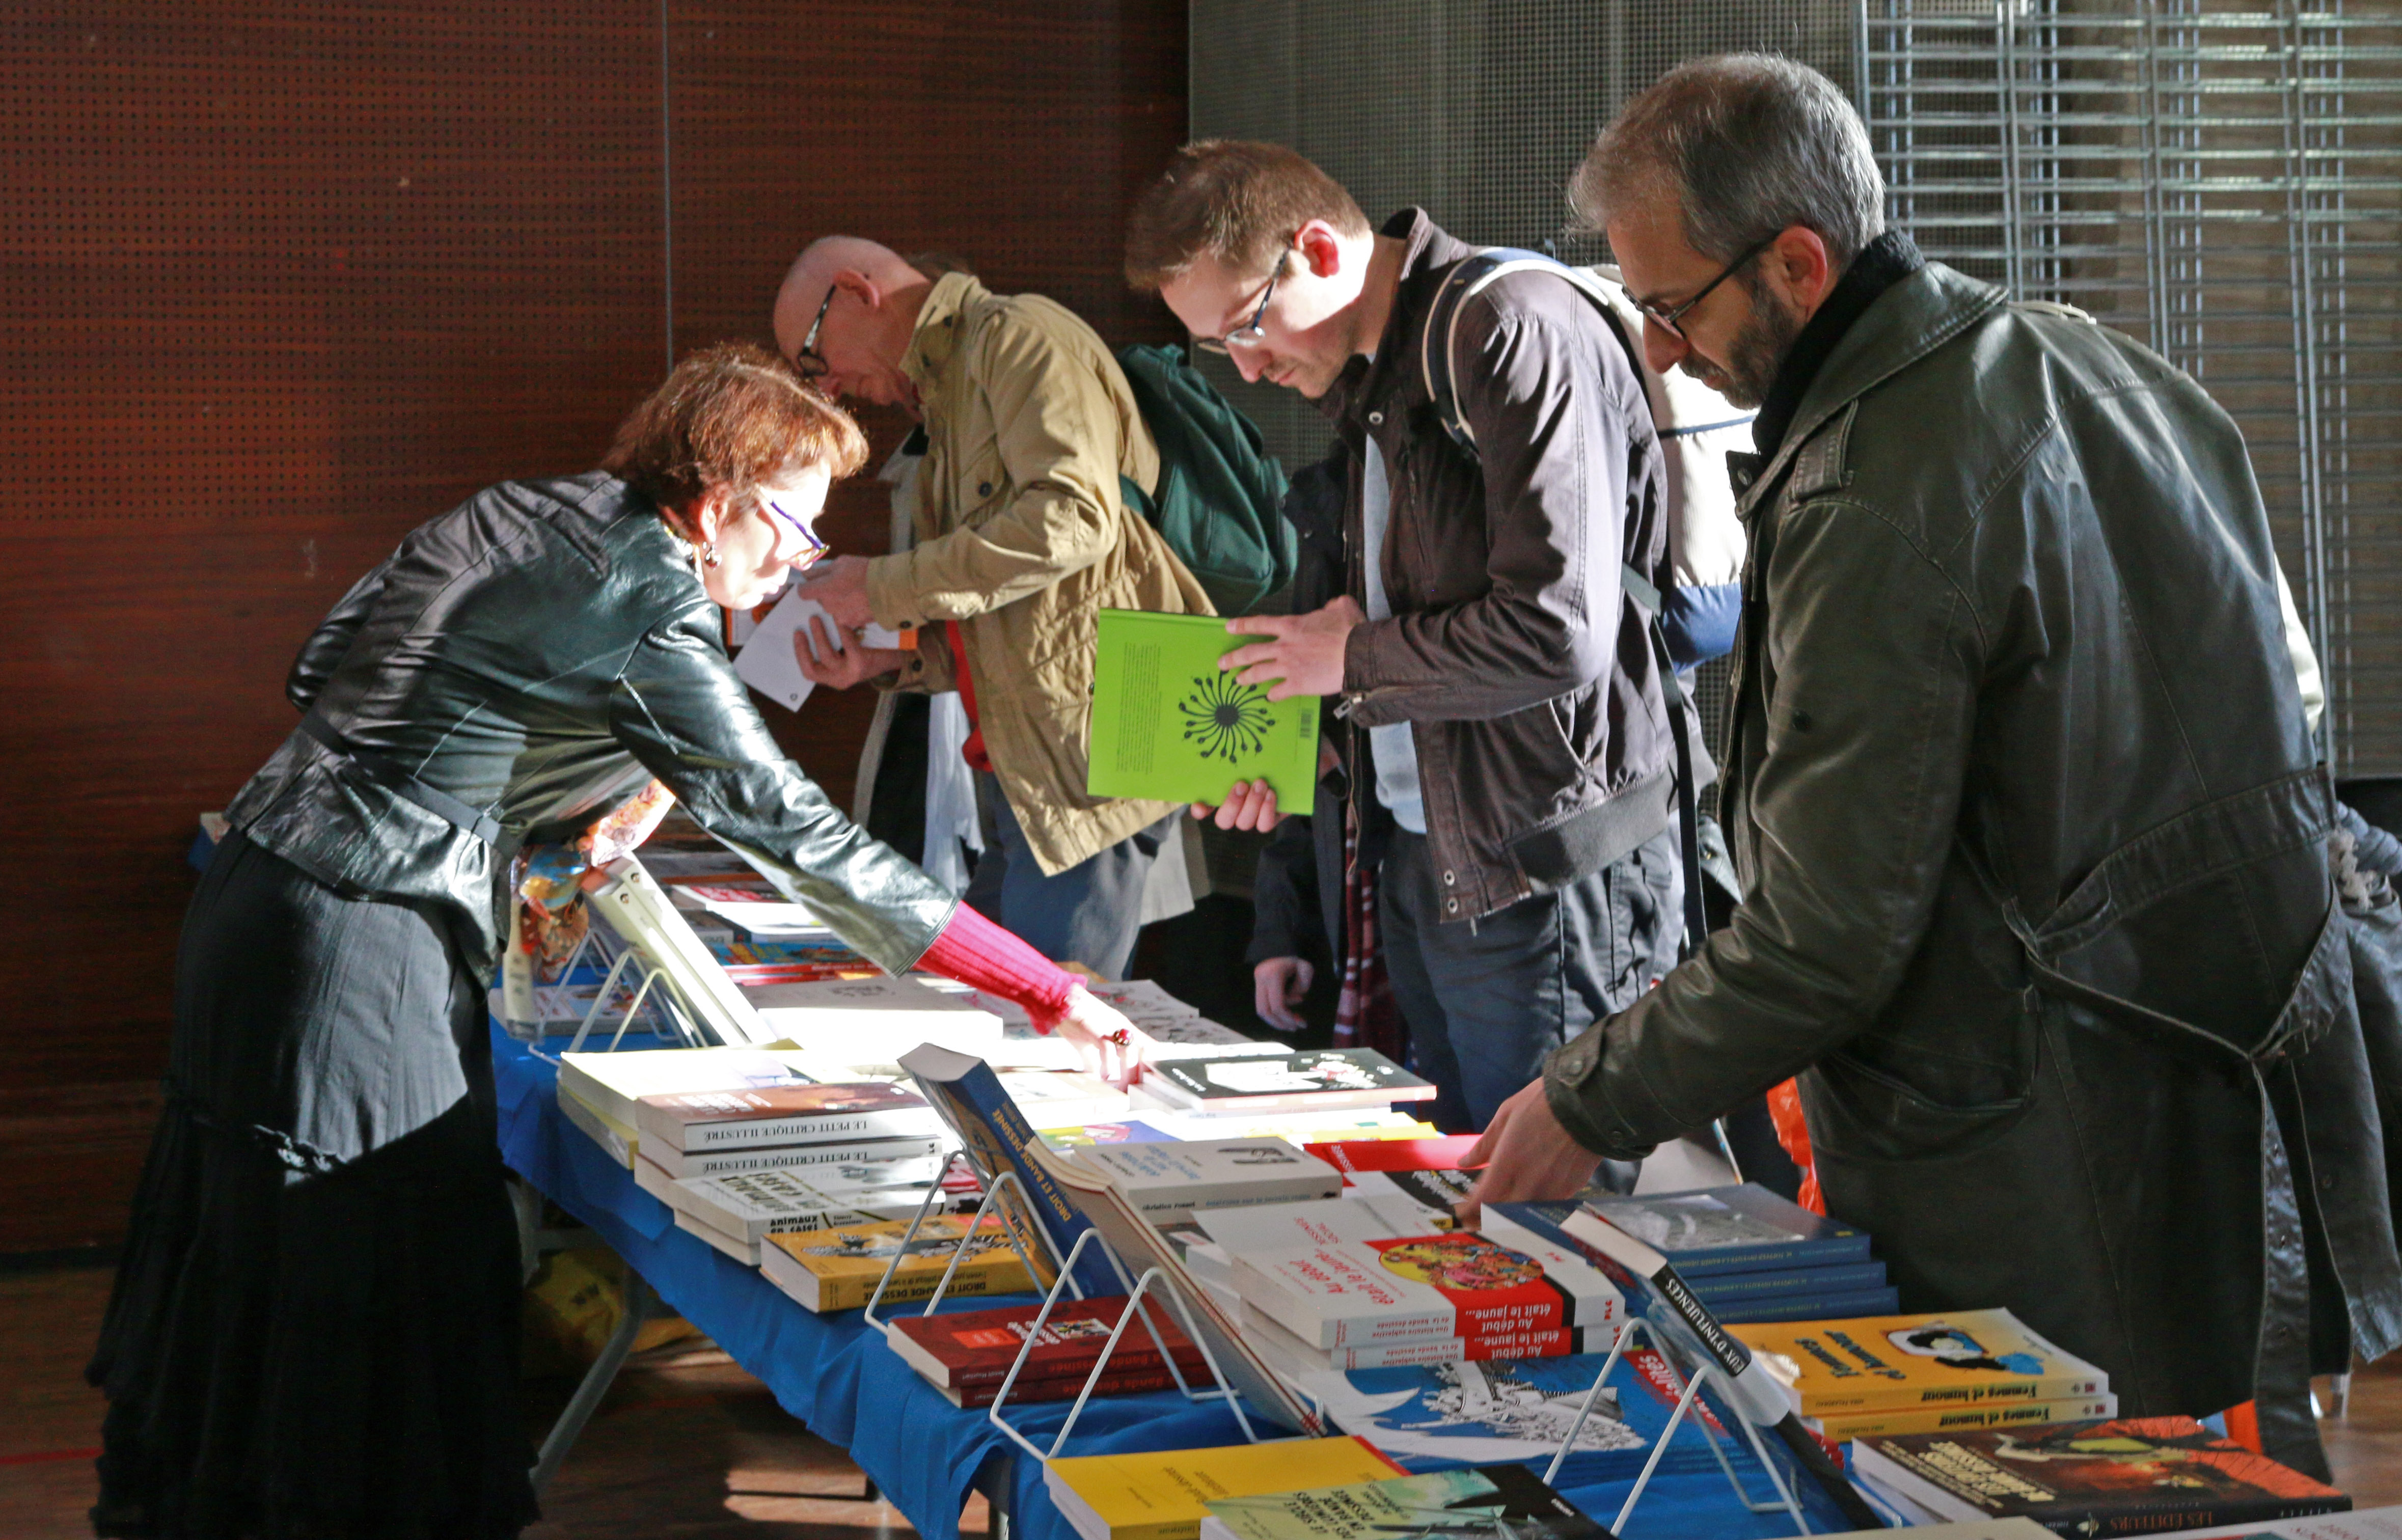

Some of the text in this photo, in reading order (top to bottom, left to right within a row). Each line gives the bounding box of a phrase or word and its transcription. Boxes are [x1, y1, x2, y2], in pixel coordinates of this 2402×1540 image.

[703, 1120, 867, 1142] LE PETIT CRITIQUE ILLUSTRÉ
[703, 1151, 867, 1174] LE PETIT CRITIQUE ILLUSTRÉ
[993, 1108, 1072, 1222] DROIT ET BANDE DESSINÉE
[770, 1215, 817, 1226] animaux
[958, 1283, 987, 1292] DROIT
[1465, 1303, 1551, 1321] était le jaune...
[1665, 1278, 1728, 1353] D'INFLUENCES
[1372, 1329, 1406, 1338] subjective
[1377, 1321, 1406, 1329] dessinée
[1481, 1318, 1533, 1333] Au début
[1474, 1330, 1560, 1348] était le jaune...
[1417, 1345, 1438, 1354] bande
[1491, 1345, 1542, 1360] Au début
[1382, 1356, 1416, 1366] subjective
[1921, 1385, 2037, 1402] Femmes et humour
[1939, 1408, 2050, 1427] Femmes et humour
[2110, 1511, 2213, 1530] LES ÉDITEURS
